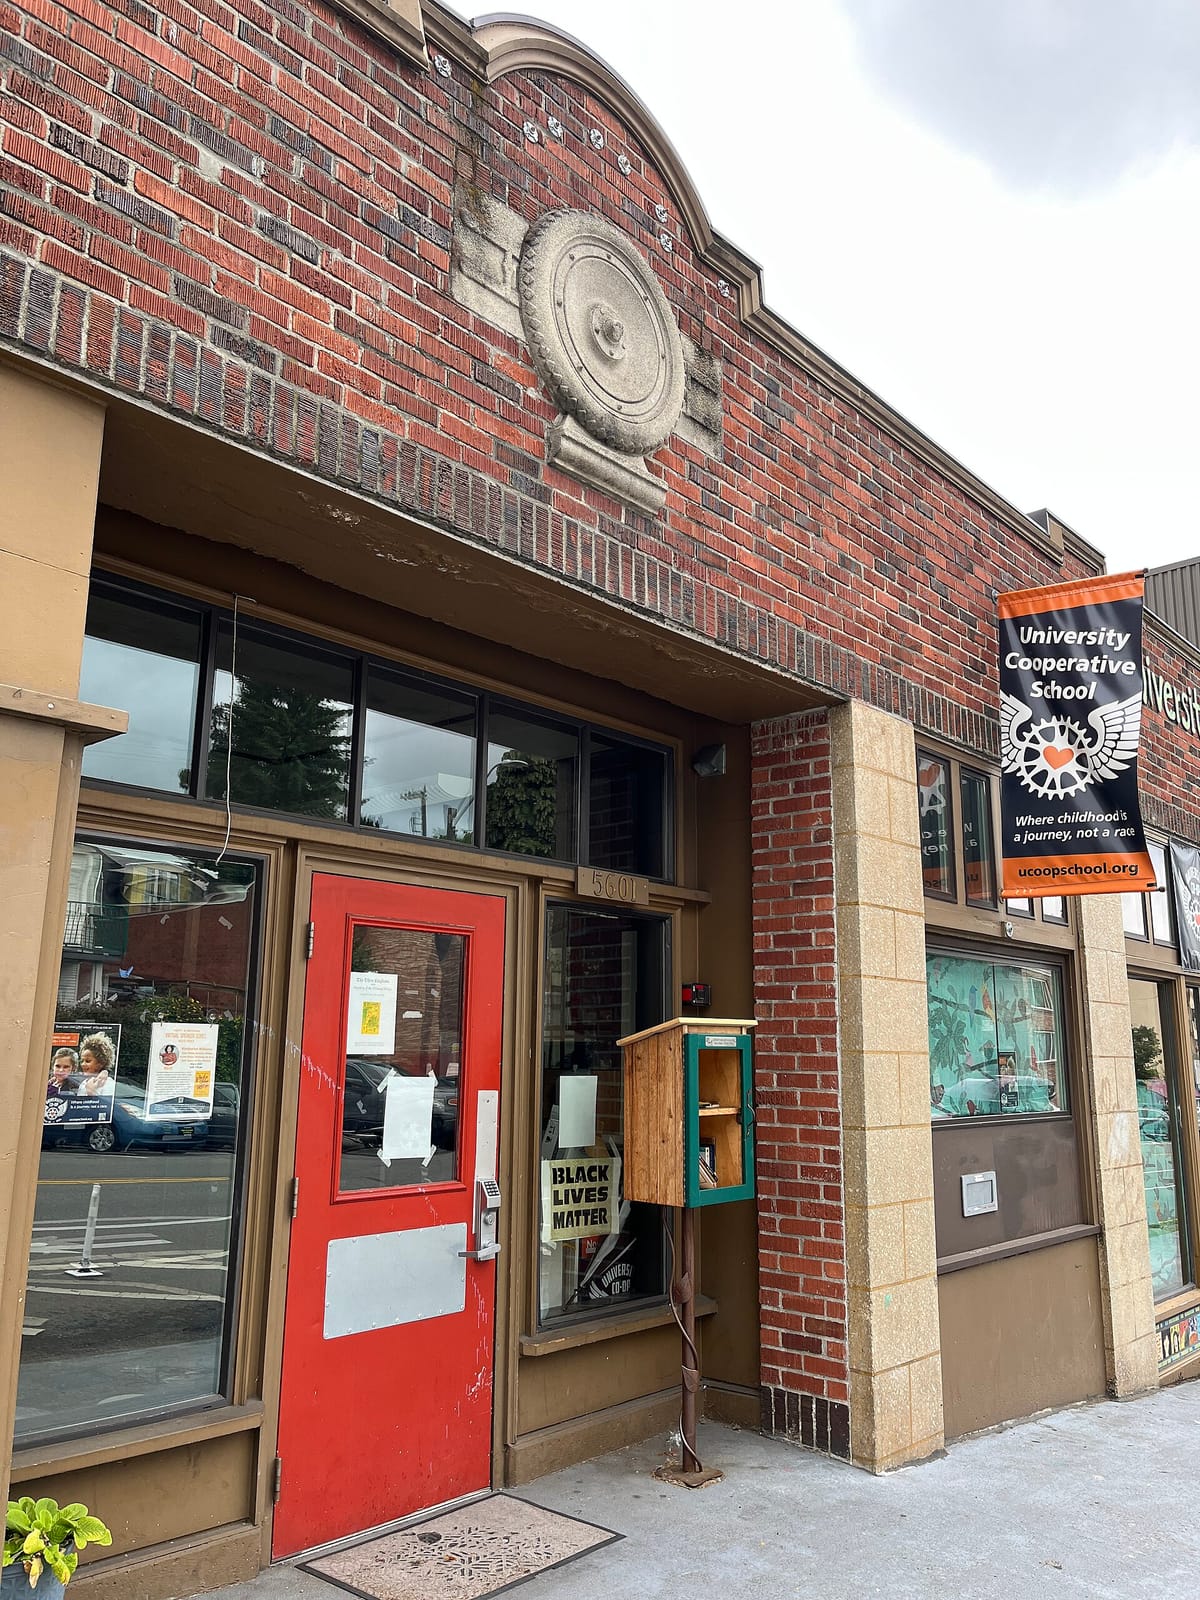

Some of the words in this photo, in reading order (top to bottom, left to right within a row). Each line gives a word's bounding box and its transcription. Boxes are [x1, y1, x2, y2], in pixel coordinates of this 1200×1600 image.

[1020, 626, 1131, 651] University
[1005, 652, 1136, 676] Cooperative
[1030, 680, 1097, 700] School
[1015, 815, 1054, 826] Where
[1057, 810, 1119, 824] childhood
[1120, 810, 1128, 820] is
[1013, 833, 1021, 842] a
[1022, 829, 1073, 844] journey,
[1076, 827, 1098, 838] not
[1102, 828, 1110, 837] a
[1114, 827, 1136, 836] race
[1018, 862, 1138, 878] ucoopschool.org
[592, 870, 636, 902] 5601
[552, 1165, 609, 1184] BLACK
[553, 1186, 608, 1206] LIVES
[553, 1208, 608, 1230] MATTER
